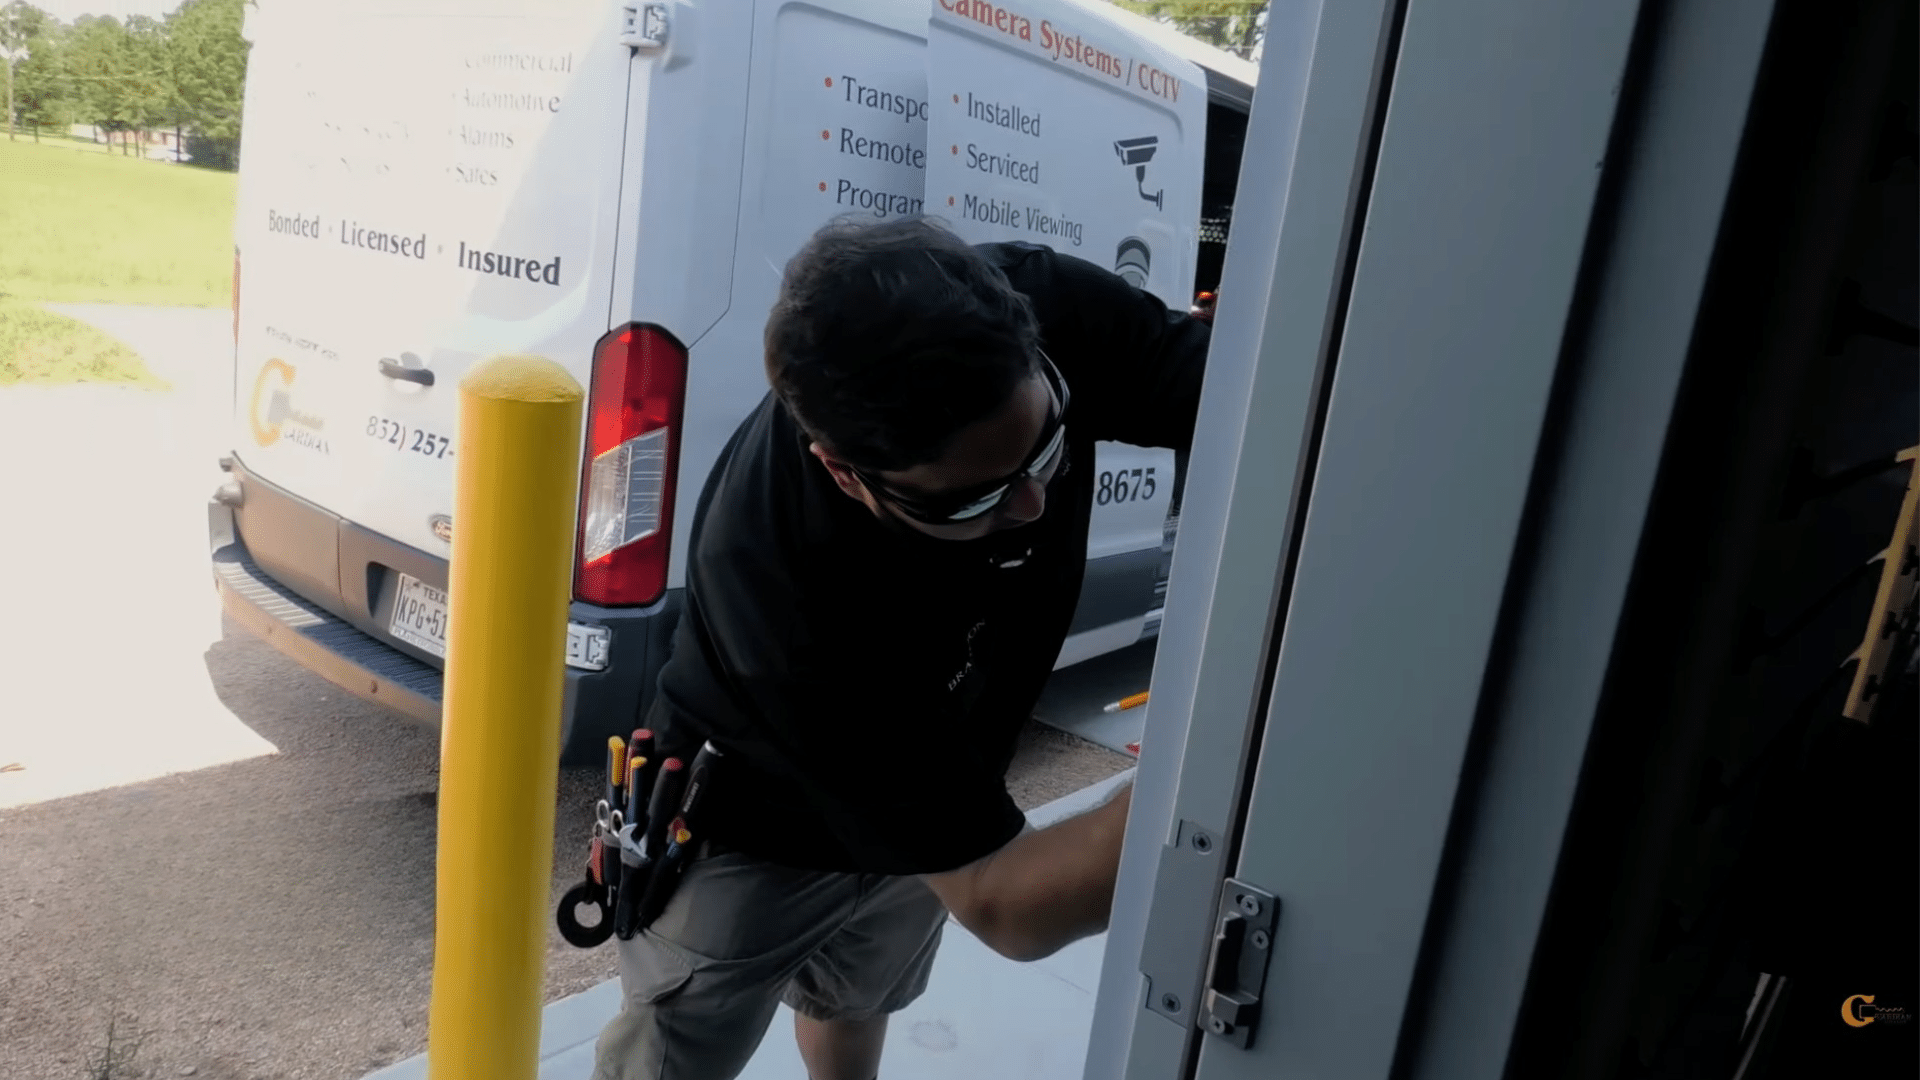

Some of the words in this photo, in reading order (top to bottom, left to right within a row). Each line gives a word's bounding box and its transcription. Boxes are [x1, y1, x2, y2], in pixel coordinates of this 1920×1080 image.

[1040, 20, 1122, 79] Systems
[1138, 63, 1181, 103] CCTV
[967, 92, 1041, 138] Installed
[840, 127, 925, 169] Remote
[966, 144, 1039, 184] Serviced
[963, 194, 1020, 228] Mobile
[1026, 208, 1083, 247] Viewing
[269, 208, 320, 239] Bonded
[340, 219, 426, 261] Licensed
[458, 241, 562, 287] Insured
[1097, 467, 1157, 506] 8675
